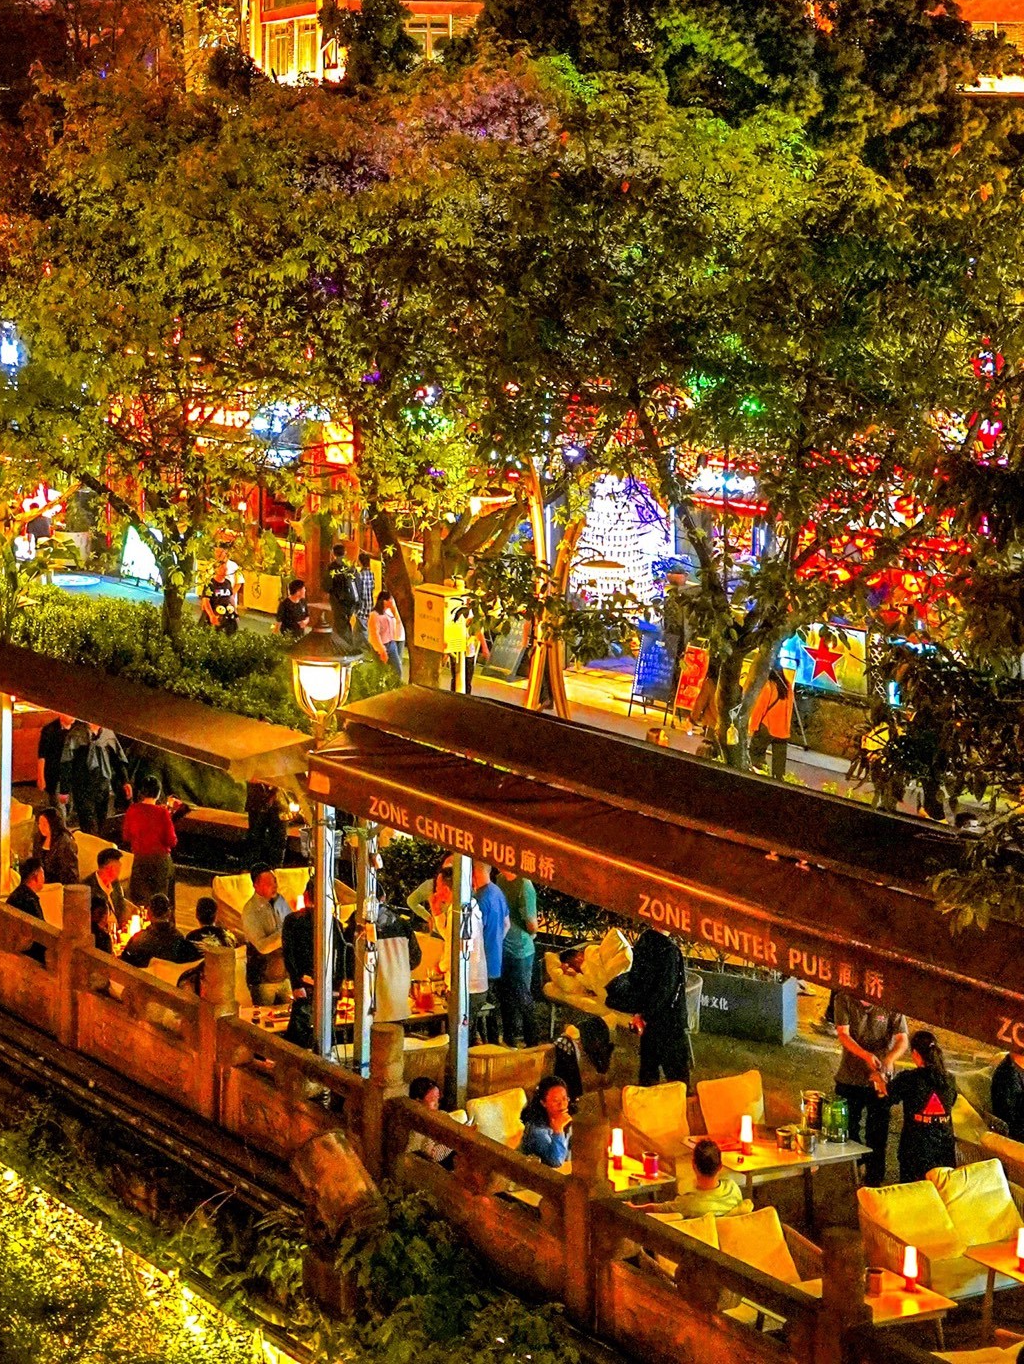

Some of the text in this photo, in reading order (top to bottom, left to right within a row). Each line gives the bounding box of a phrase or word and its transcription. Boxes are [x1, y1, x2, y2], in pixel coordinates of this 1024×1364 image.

[215, 588, 231, 597] FILA
[369, 795, 410, 828] ZONE
[415, 814, 475, 854] CENTER
[482, 838, 516, 867] PUB
[638, 893, 692, 932] ZONE
[700, 917, 778, 964] CENTER
[789, 947, 833, 981] PUB
